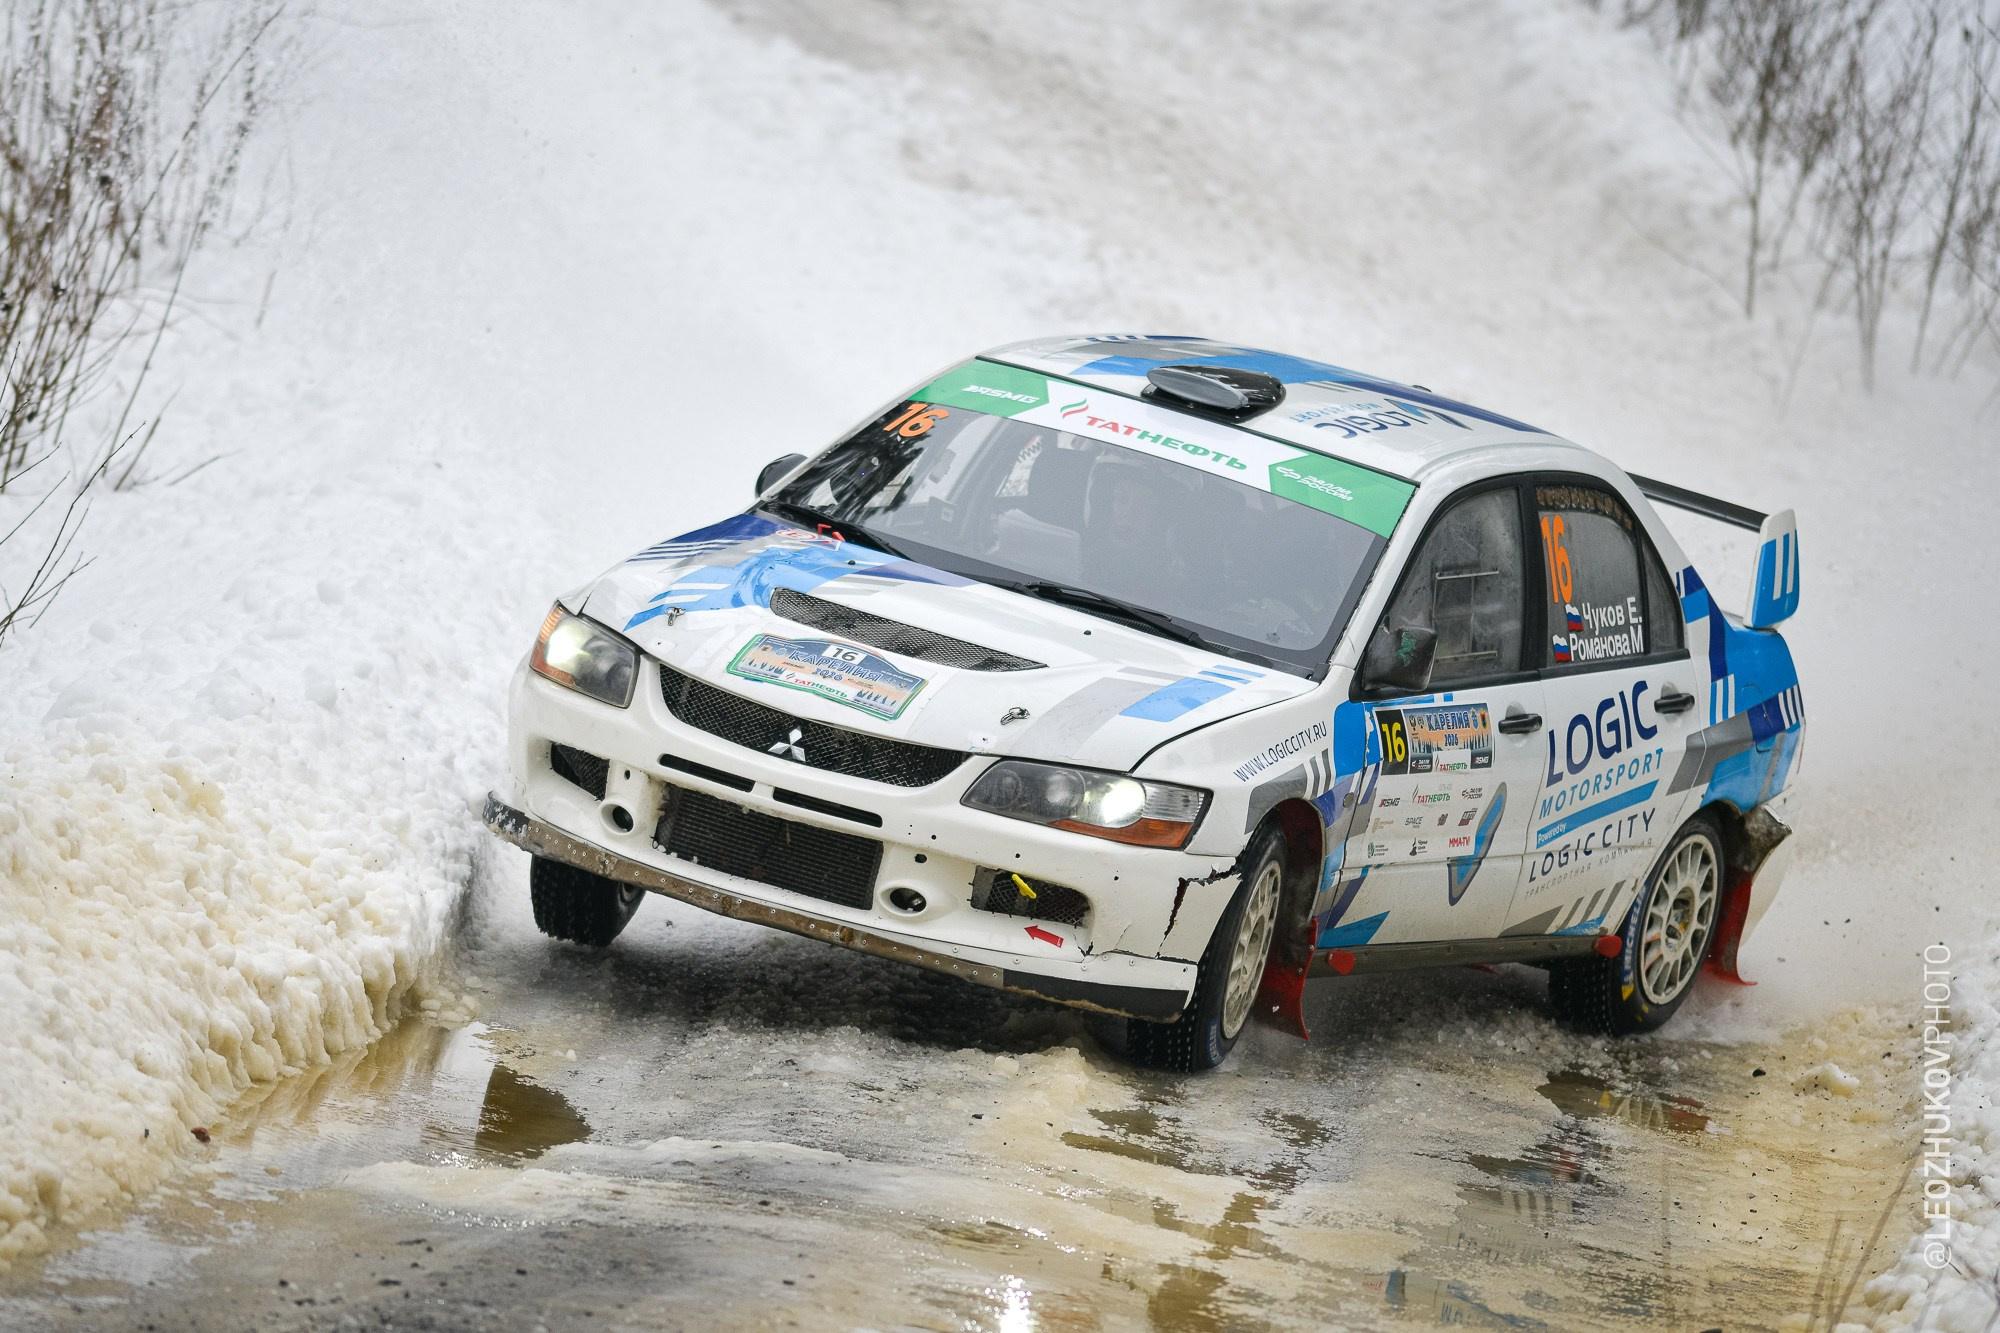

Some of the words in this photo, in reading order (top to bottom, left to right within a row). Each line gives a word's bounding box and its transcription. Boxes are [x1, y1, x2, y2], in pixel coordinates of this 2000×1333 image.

[883, 403, 949, 437] 16
[1313, 411, 1428, 439] LOGIC
[1086, 415, 1248, 470] ТАТНЕФТЬ
[1540, 514, 1573, 604] 16
[1582, 602, 1625, 636] Чуков
[1627, 596, 1643, 624] Е.
[830, 647, 859, 662] 16
[1569, 632, 1629, 662] Романова
[1629, 624, 1644, 653] М
[788, 650, 884, 682] КАРЕЛИЯ
[793, 678, 848, 698] ТАТНЕФТЬ
[1425, 710, 1471, 731] КАРЕЛИЯ
[1545, 680, 1658, 788] LOGIC
[1232, 720, 1327, 782] WWW.LOGICCITY.RU
[1381, 722, 1406, 763] 16
[1440, 762, 1468, 772] ТАТНЕФТЬ
[1538, 747, 1664, 820] MOTORSPORT
[1417, 793, 1451, 804] ТАТНЕФТЬ
[1525, 862, 1592, 899] ТРАНСПОРТНАЯ
